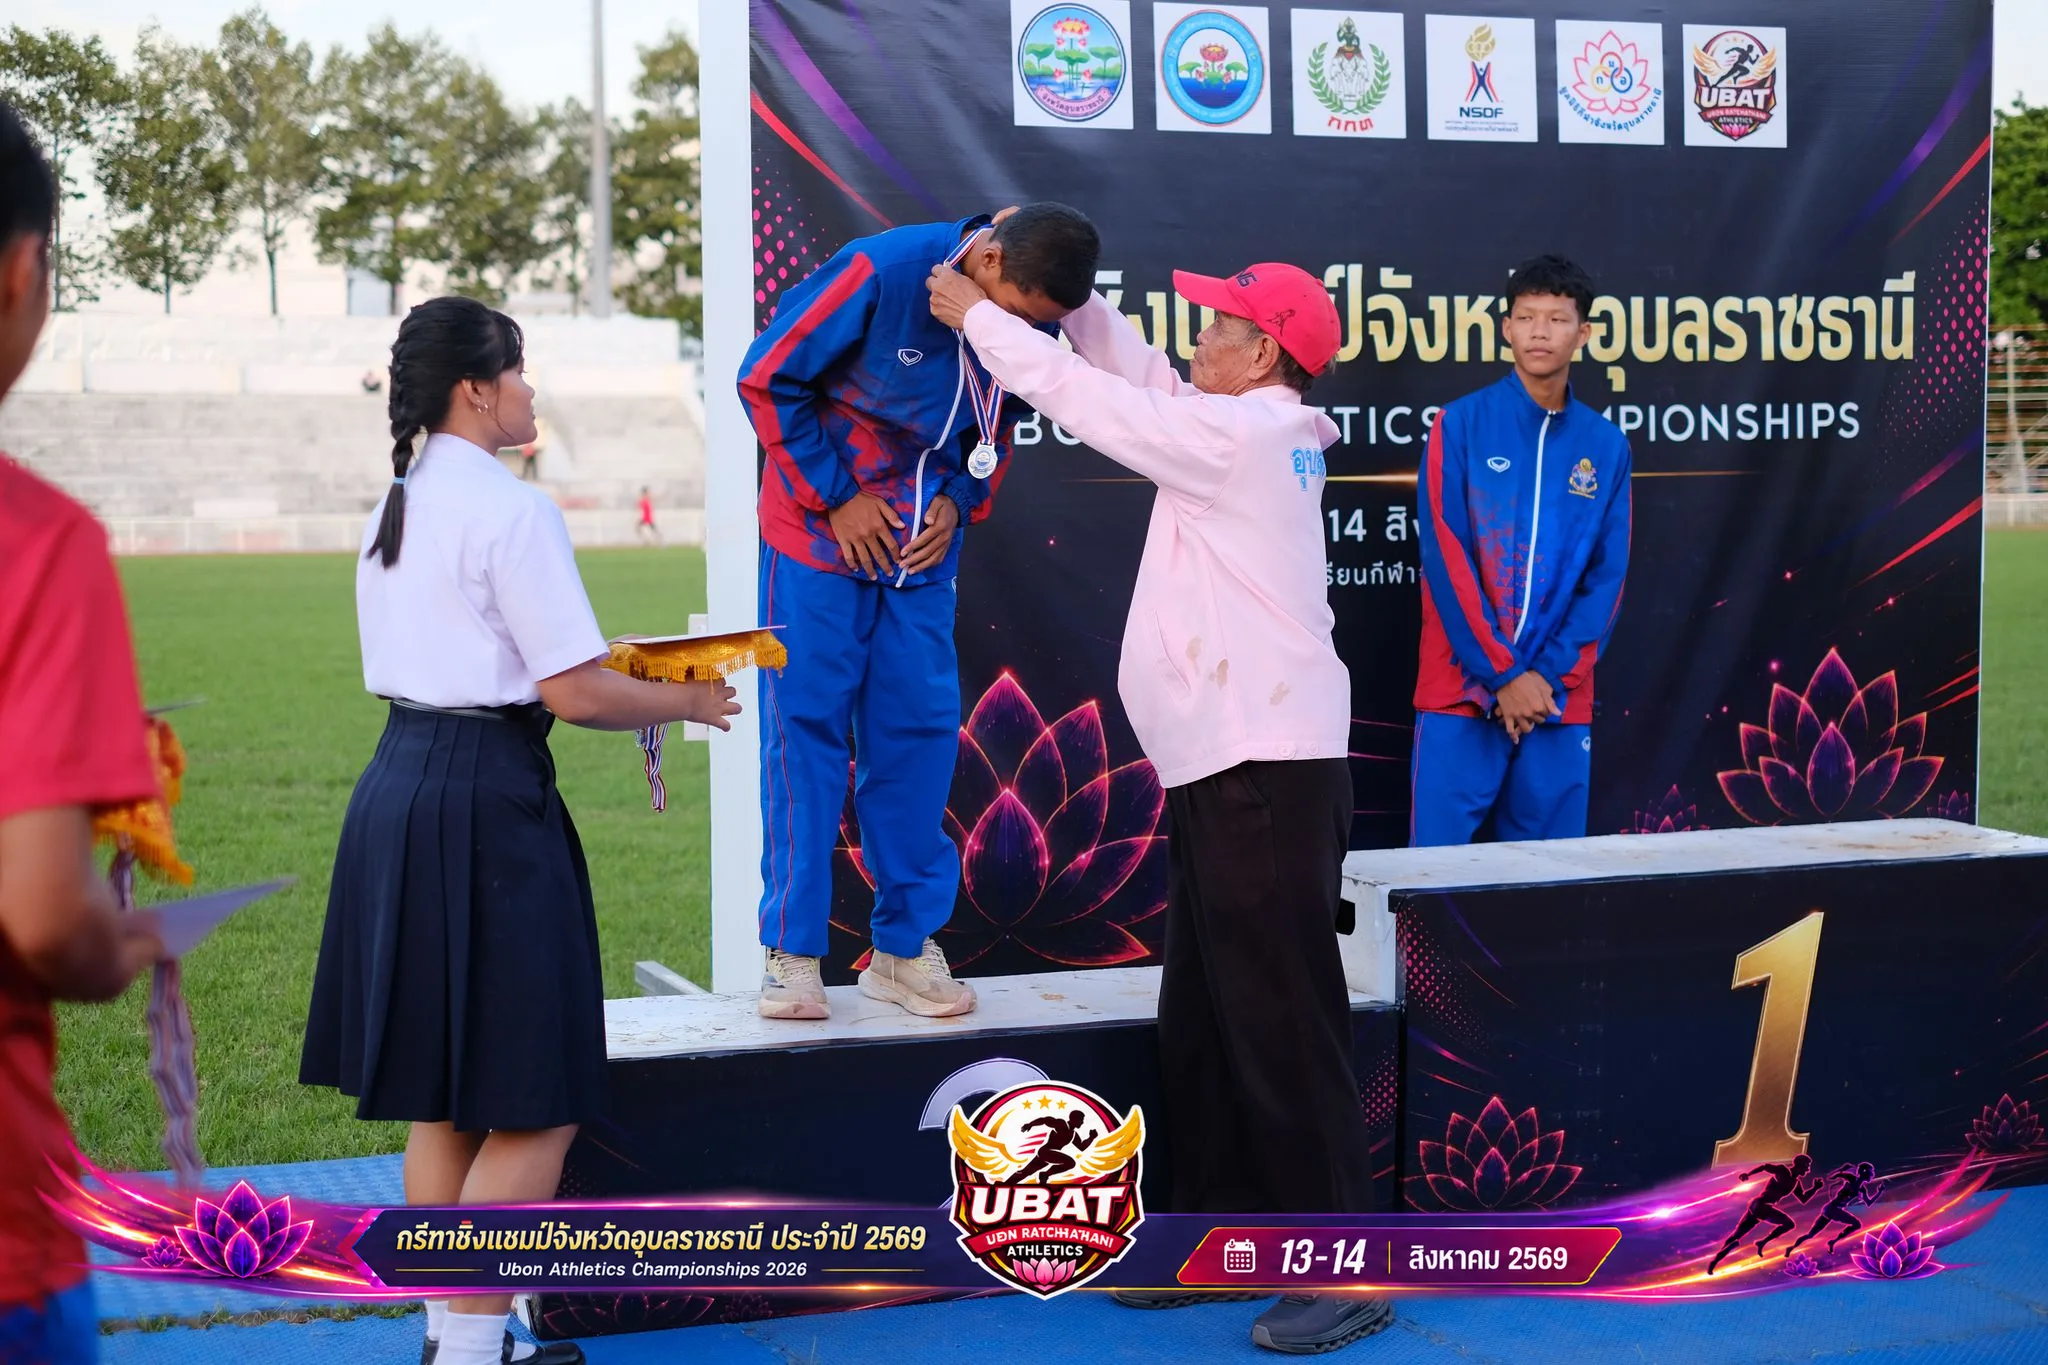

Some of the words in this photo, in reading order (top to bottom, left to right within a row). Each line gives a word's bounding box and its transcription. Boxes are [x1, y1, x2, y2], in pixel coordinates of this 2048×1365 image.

[1459, 106, 1504, 118] NSDF
[1700, 86, 1771, 109] UBAT
[1602, 401, 1860, 442] PIONSHIPS
[1711, 911, 1825, 1170] 1
